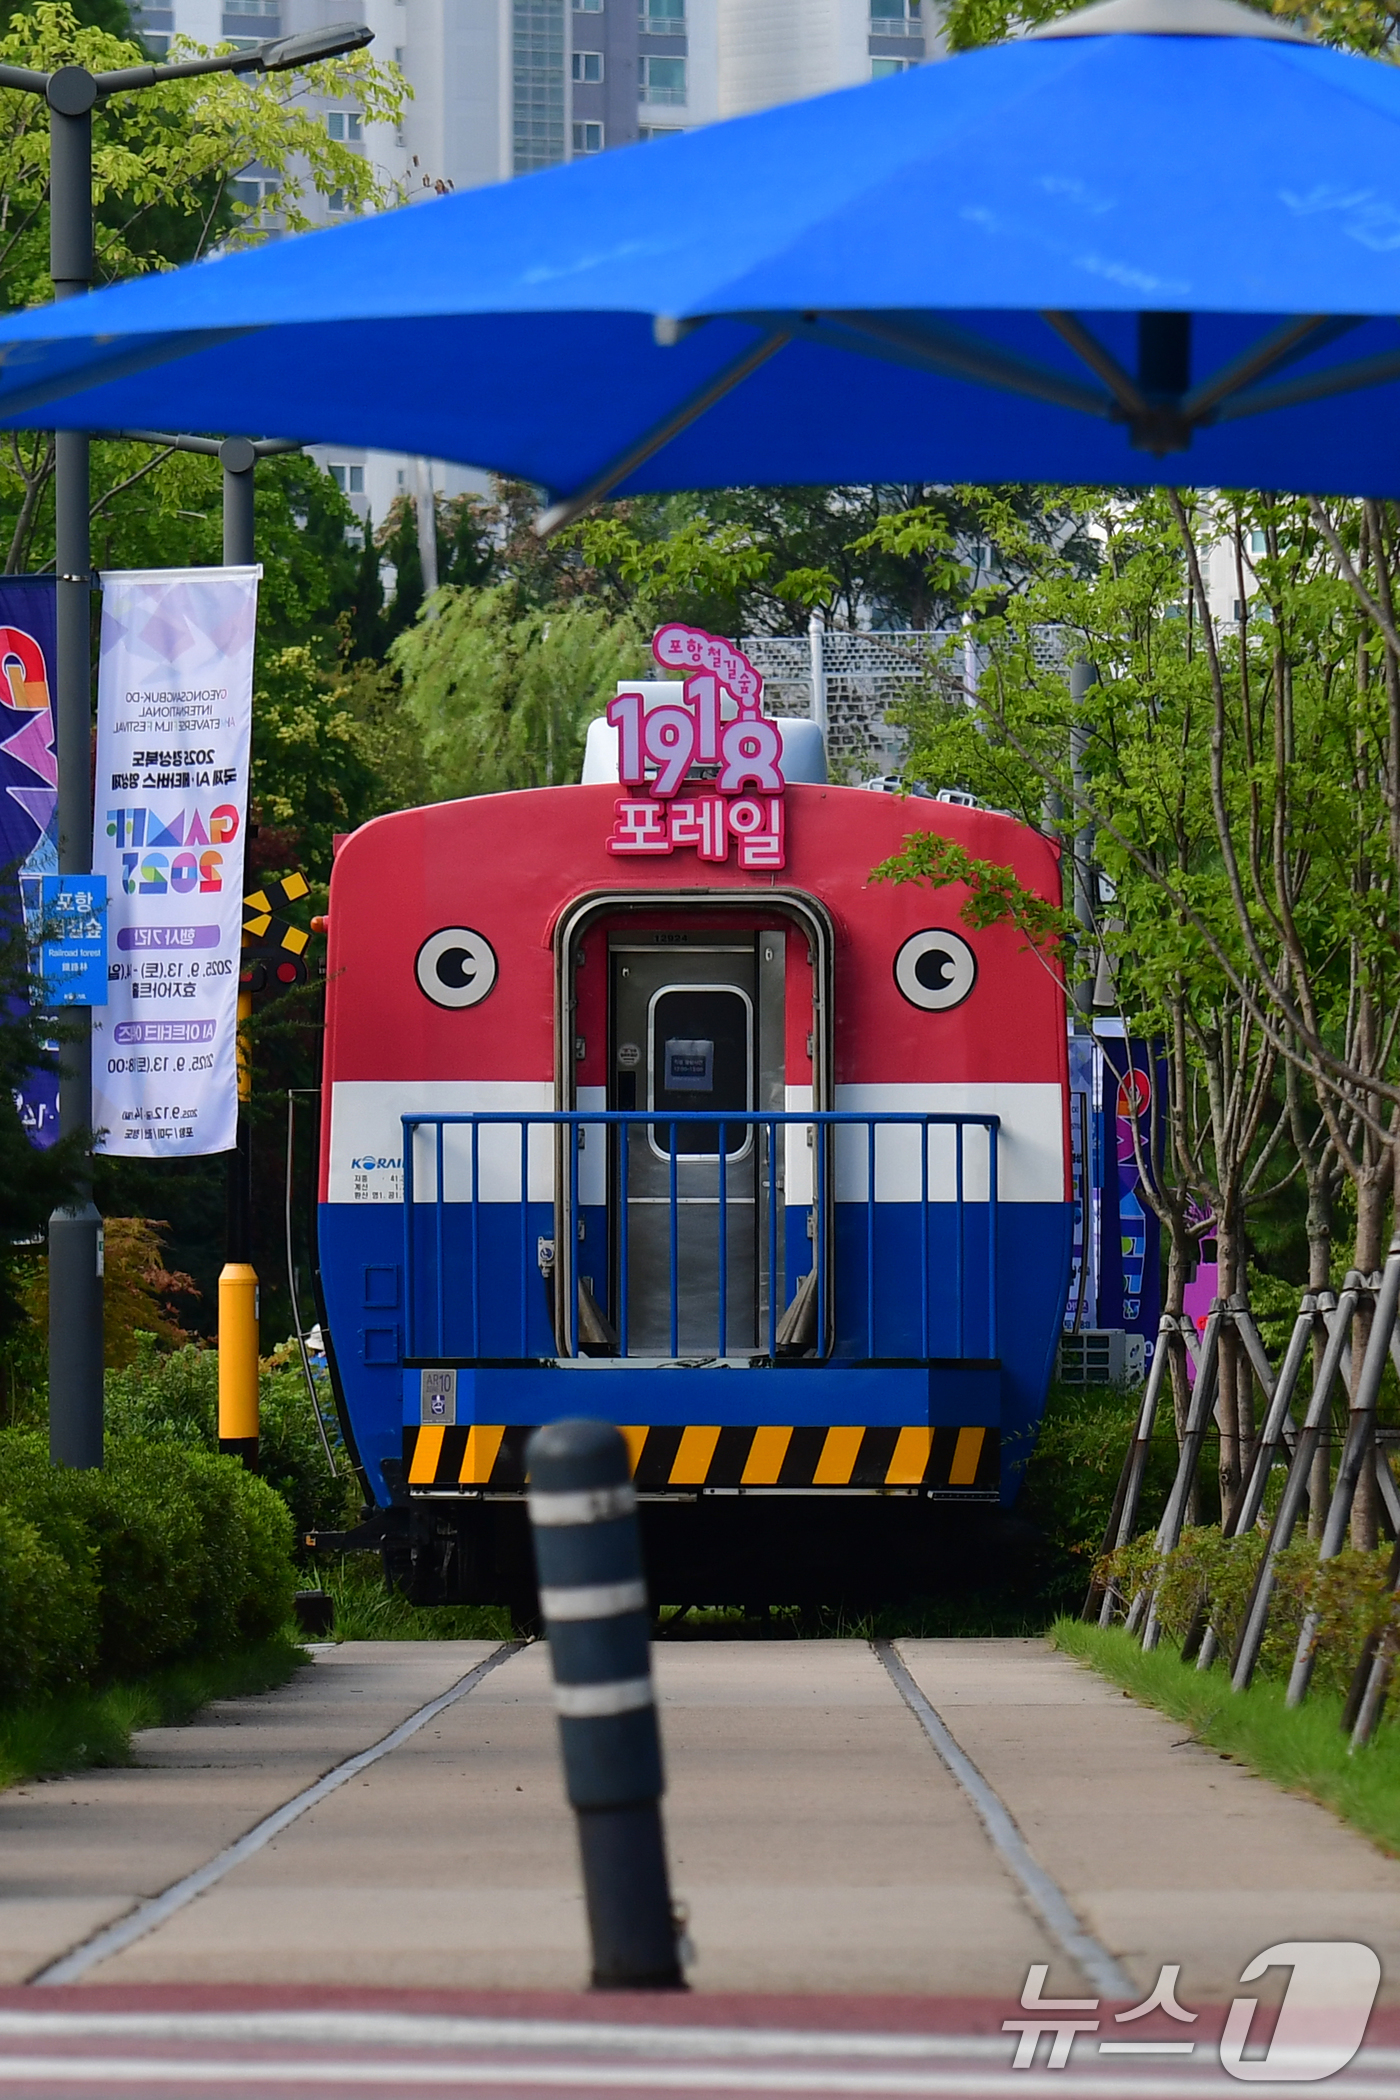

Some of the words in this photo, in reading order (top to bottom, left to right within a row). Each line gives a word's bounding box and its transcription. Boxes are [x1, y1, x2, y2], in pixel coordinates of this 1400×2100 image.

[608, 674, 784, 796] 1918
[609, 798, 783, 867] 포레일
[48, 948, 79, 957] Railroad
[80, 948, 102, 957] forest
[351, 1155, 404, 1170] KORAI
